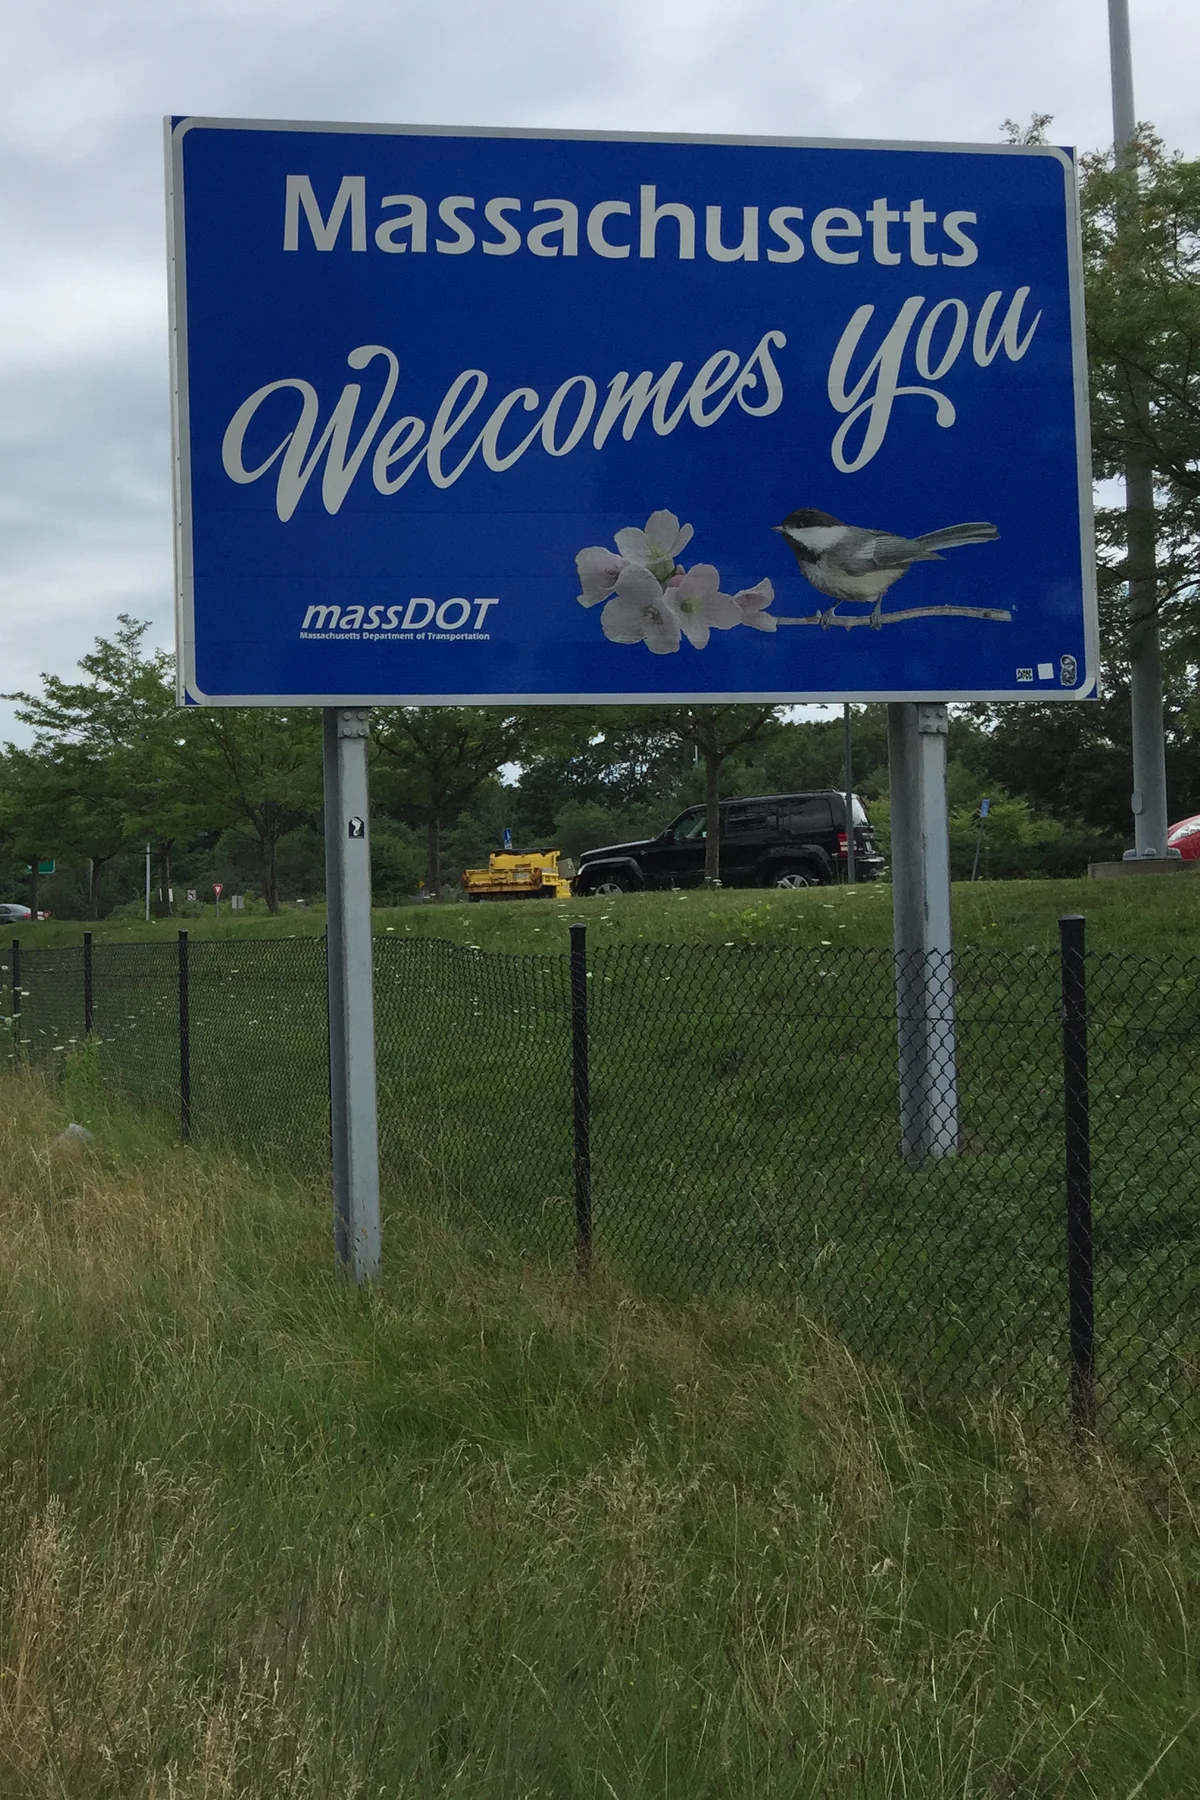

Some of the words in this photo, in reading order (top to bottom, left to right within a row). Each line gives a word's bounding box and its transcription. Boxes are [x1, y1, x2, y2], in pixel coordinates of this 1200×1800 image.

[284, 175, 978, 267] Massachusetts
[223, 331, 786, 523] Welcomes
[299, 631, 361, 641] Massachusetts
[362, 631, 414, 642] Department
[415, 632, 426, 641] of
[427, 632, 490, 642] Transportation
[301, 598, 500, 630] massDOT
